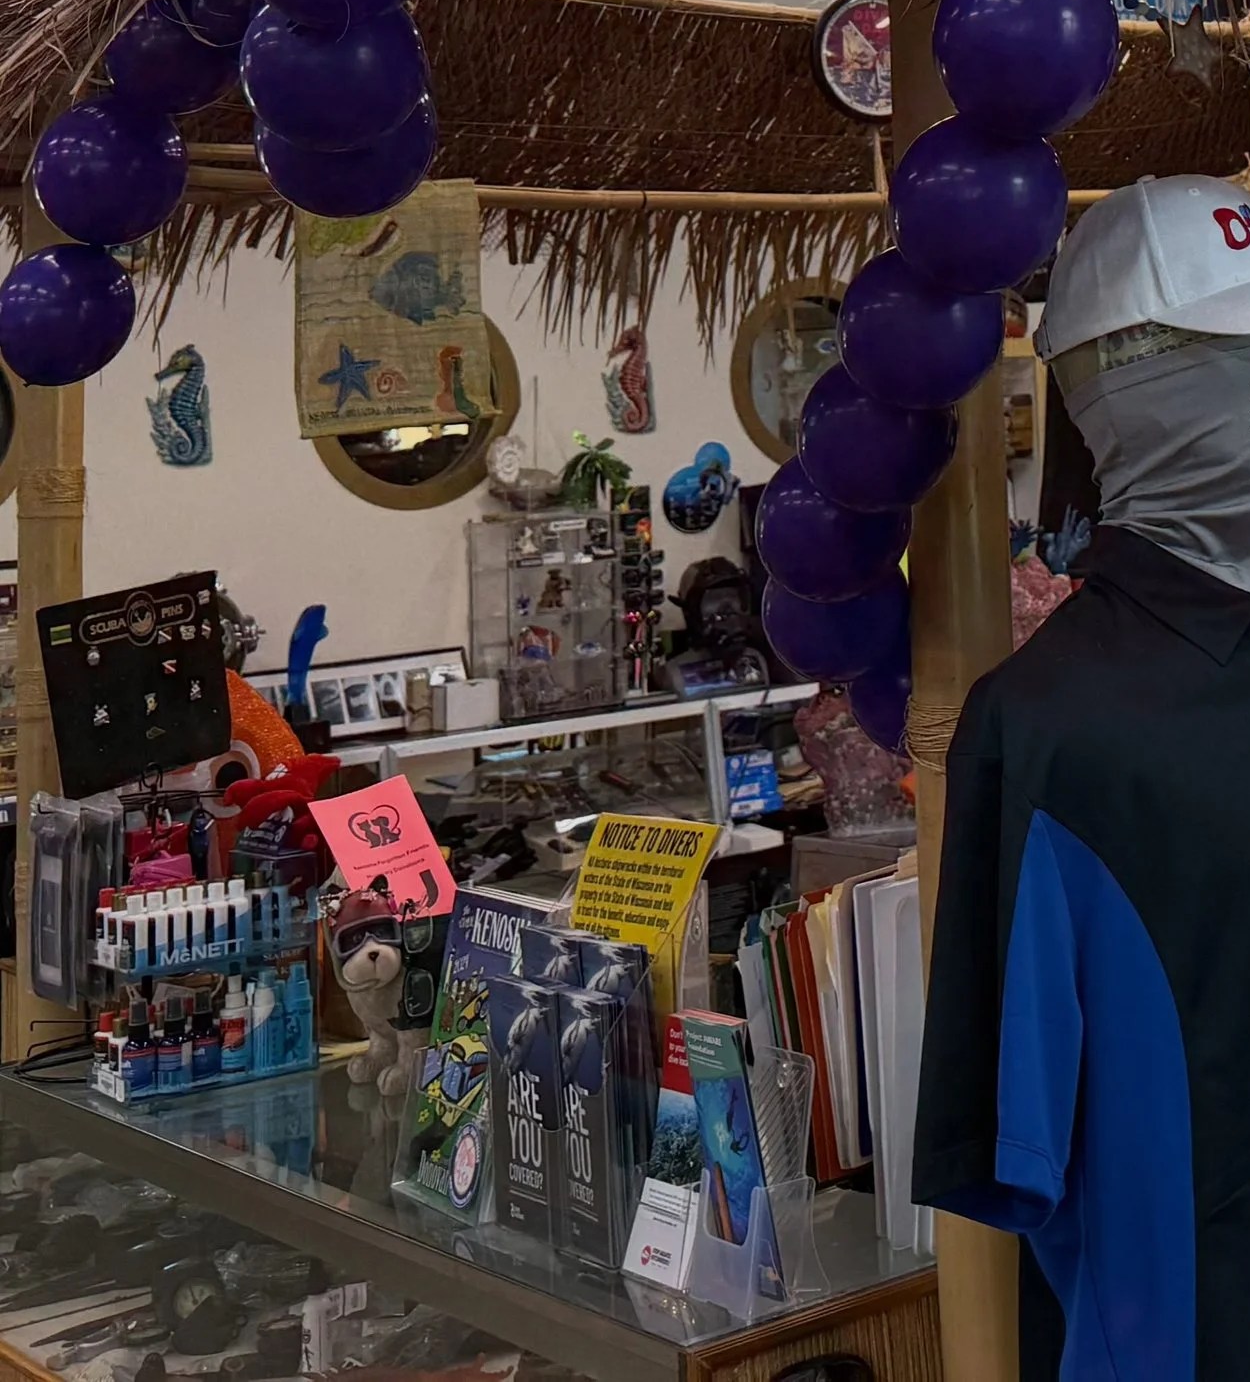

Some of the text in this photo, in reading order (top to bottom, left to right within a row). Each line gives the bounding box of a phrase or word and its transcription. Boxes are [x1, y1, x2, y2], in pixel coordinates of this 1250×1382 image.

[89, 603, 185, 636] SCUBA PINS
[599, 822, 703, 857] NOTICE TO DIVERS
[507, 1070, 543, 1121] ARE
[507, 1113, 543, 1168] YOU
[508, 1162, 544, 1190] COVERED?
